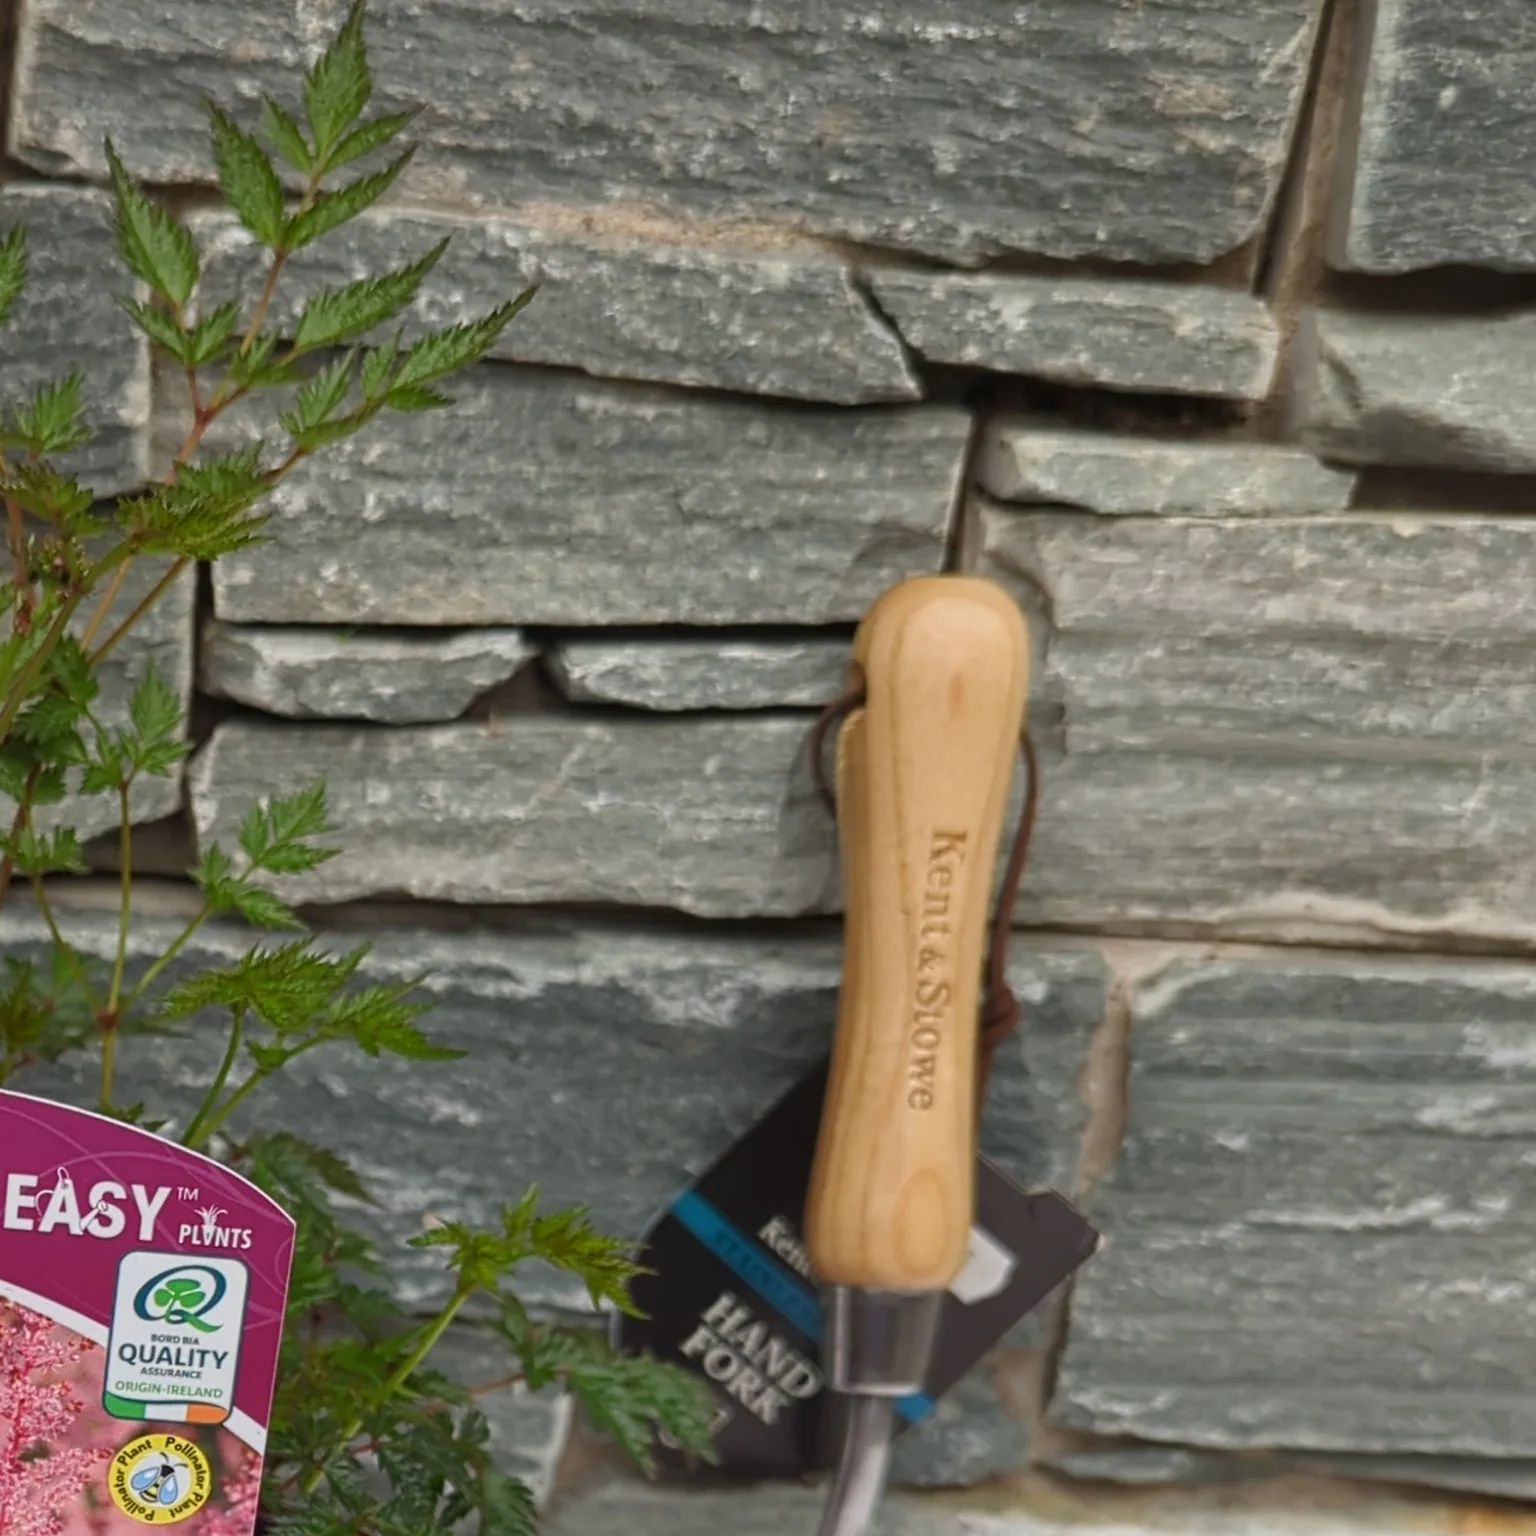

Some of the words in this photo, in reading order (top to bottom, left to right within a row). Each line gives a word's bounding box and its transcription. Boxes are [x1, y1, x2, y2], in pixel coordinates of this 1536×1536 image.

[150, 1334, 180, 1344] BORD
[182, 1337, 199, 1345] BIA
[702, 1292, 823, 1398] HAND
[118, 1343, 228, 1370] QUALITY
[140, 1367, 202, 1379] ASSURANCE
[678, 1325, 790, 1425] FORK
[115, 1380, 223, 1398] ORIGIN-IRELAND
[117, 1440, 152, 1466] Plant
[164, 1437, 207, 1490] Pollinator
[113, 1468, 155, 1521] Pollinator
[168, 1491, 204, 1518] Plant
